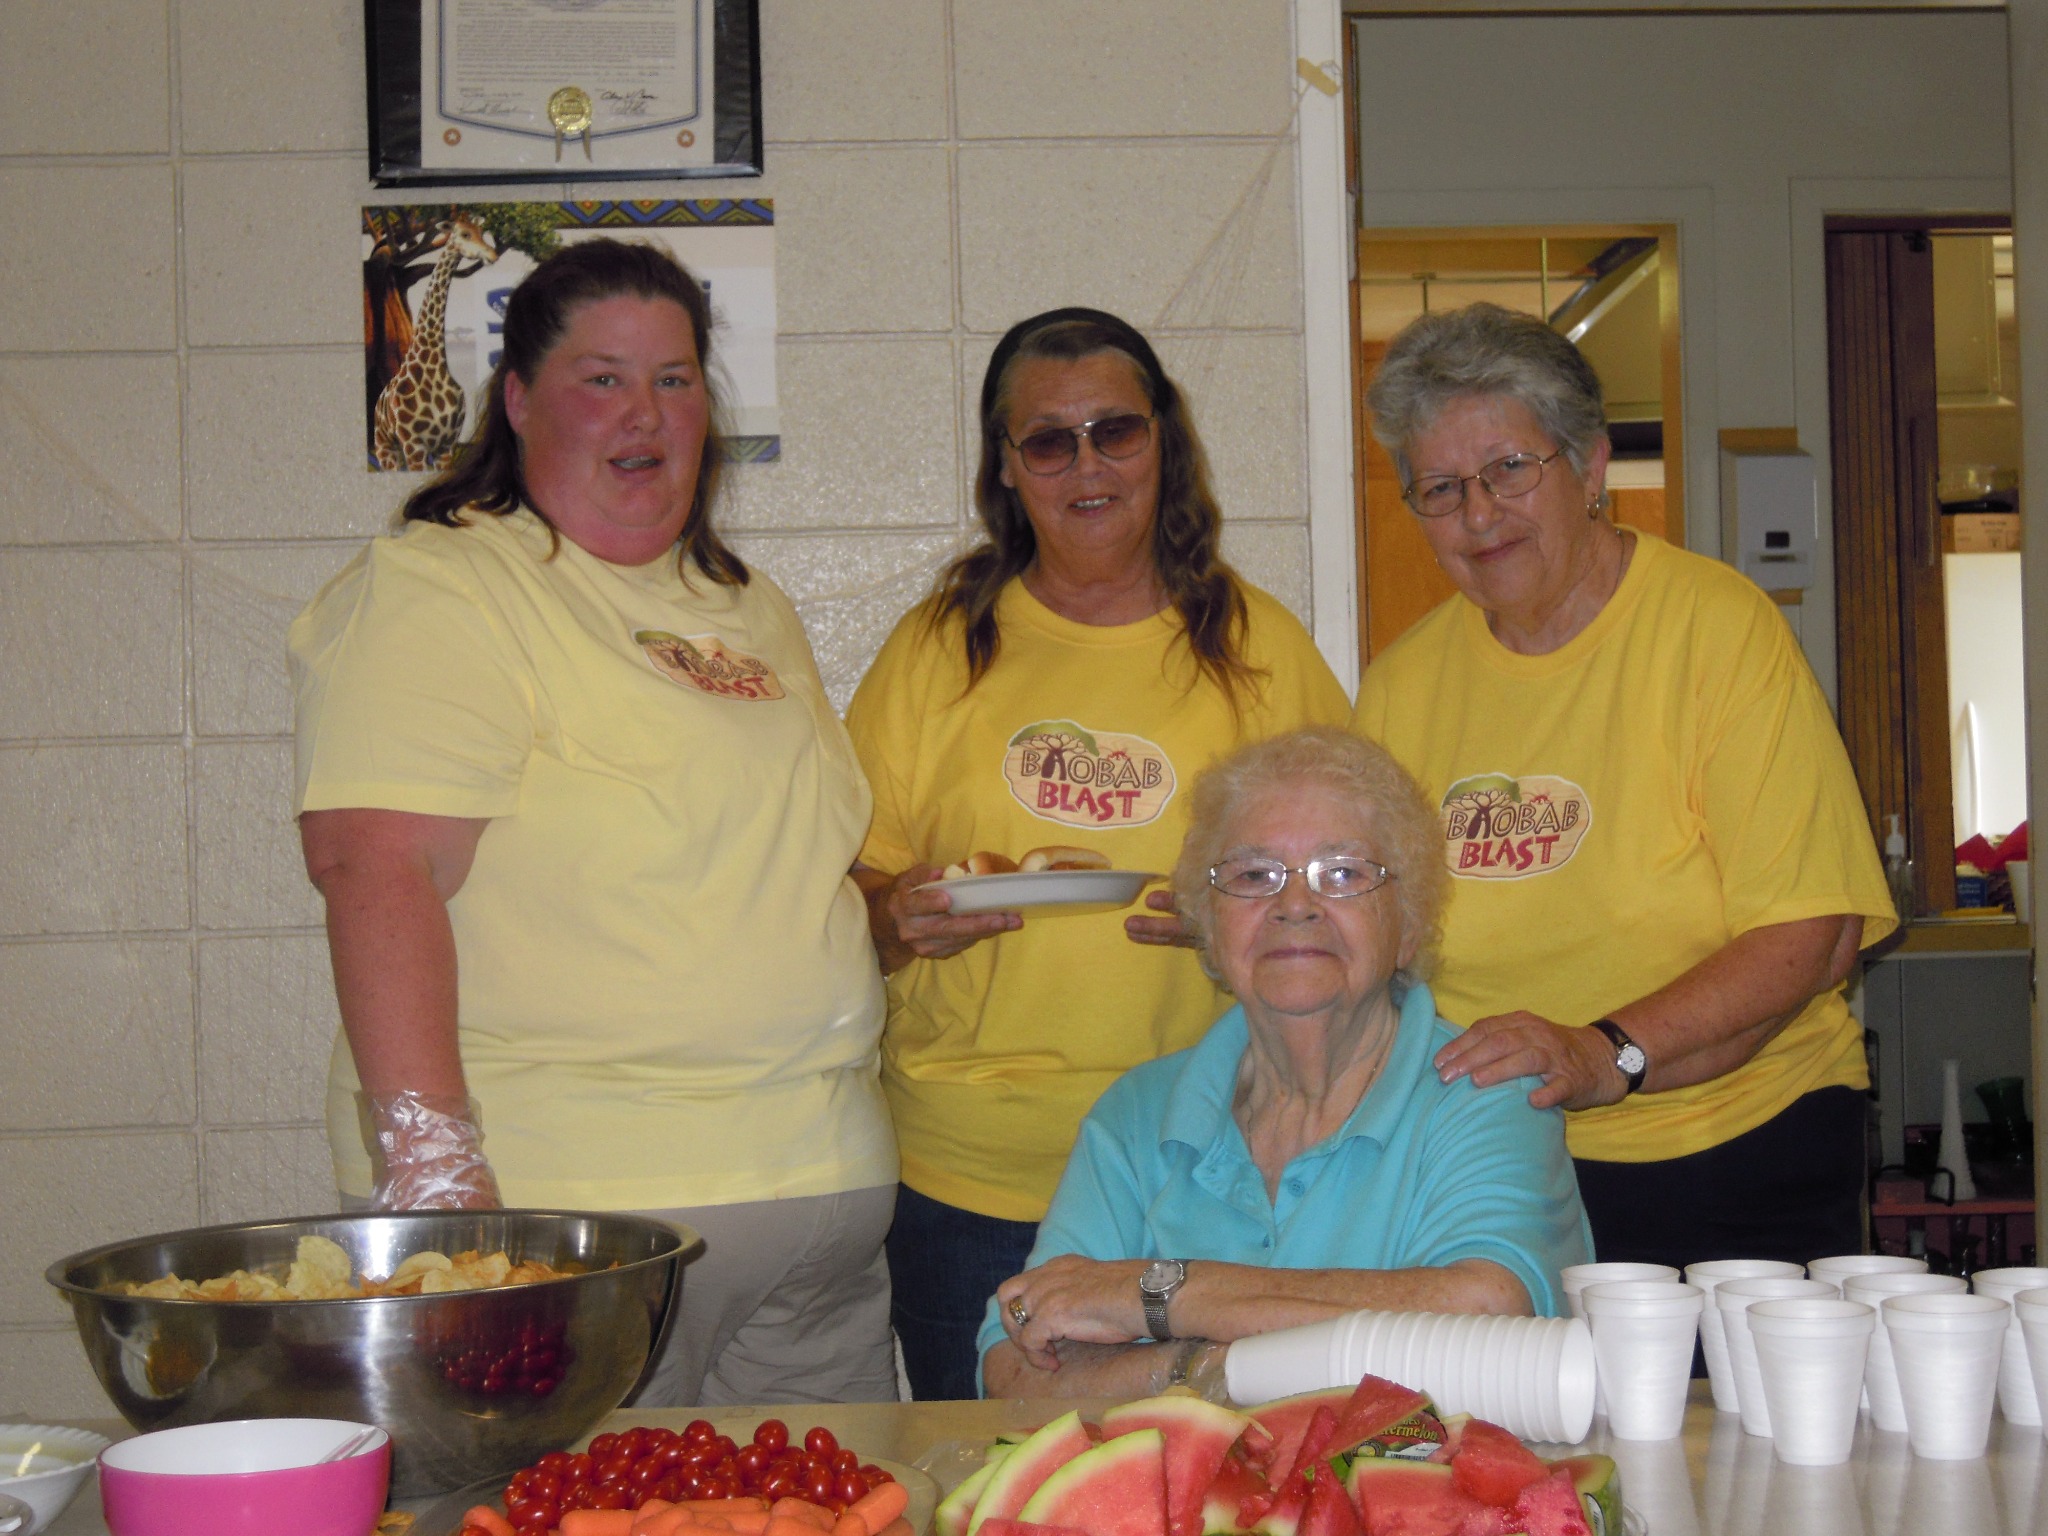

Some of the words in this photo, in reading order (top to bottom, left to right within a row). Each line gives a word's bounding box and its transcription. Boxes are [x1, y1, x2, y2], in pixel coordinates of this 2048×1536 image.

[1020, 749, 1163, 789] BAOBAB
[1037, 780, 1142, 822] BLAST
[1446, 800, 1580, 840] BAOBAB
[1458, 833, 1561, 872] BLAST
[1380, 1424, 1438, 1441] termelon
